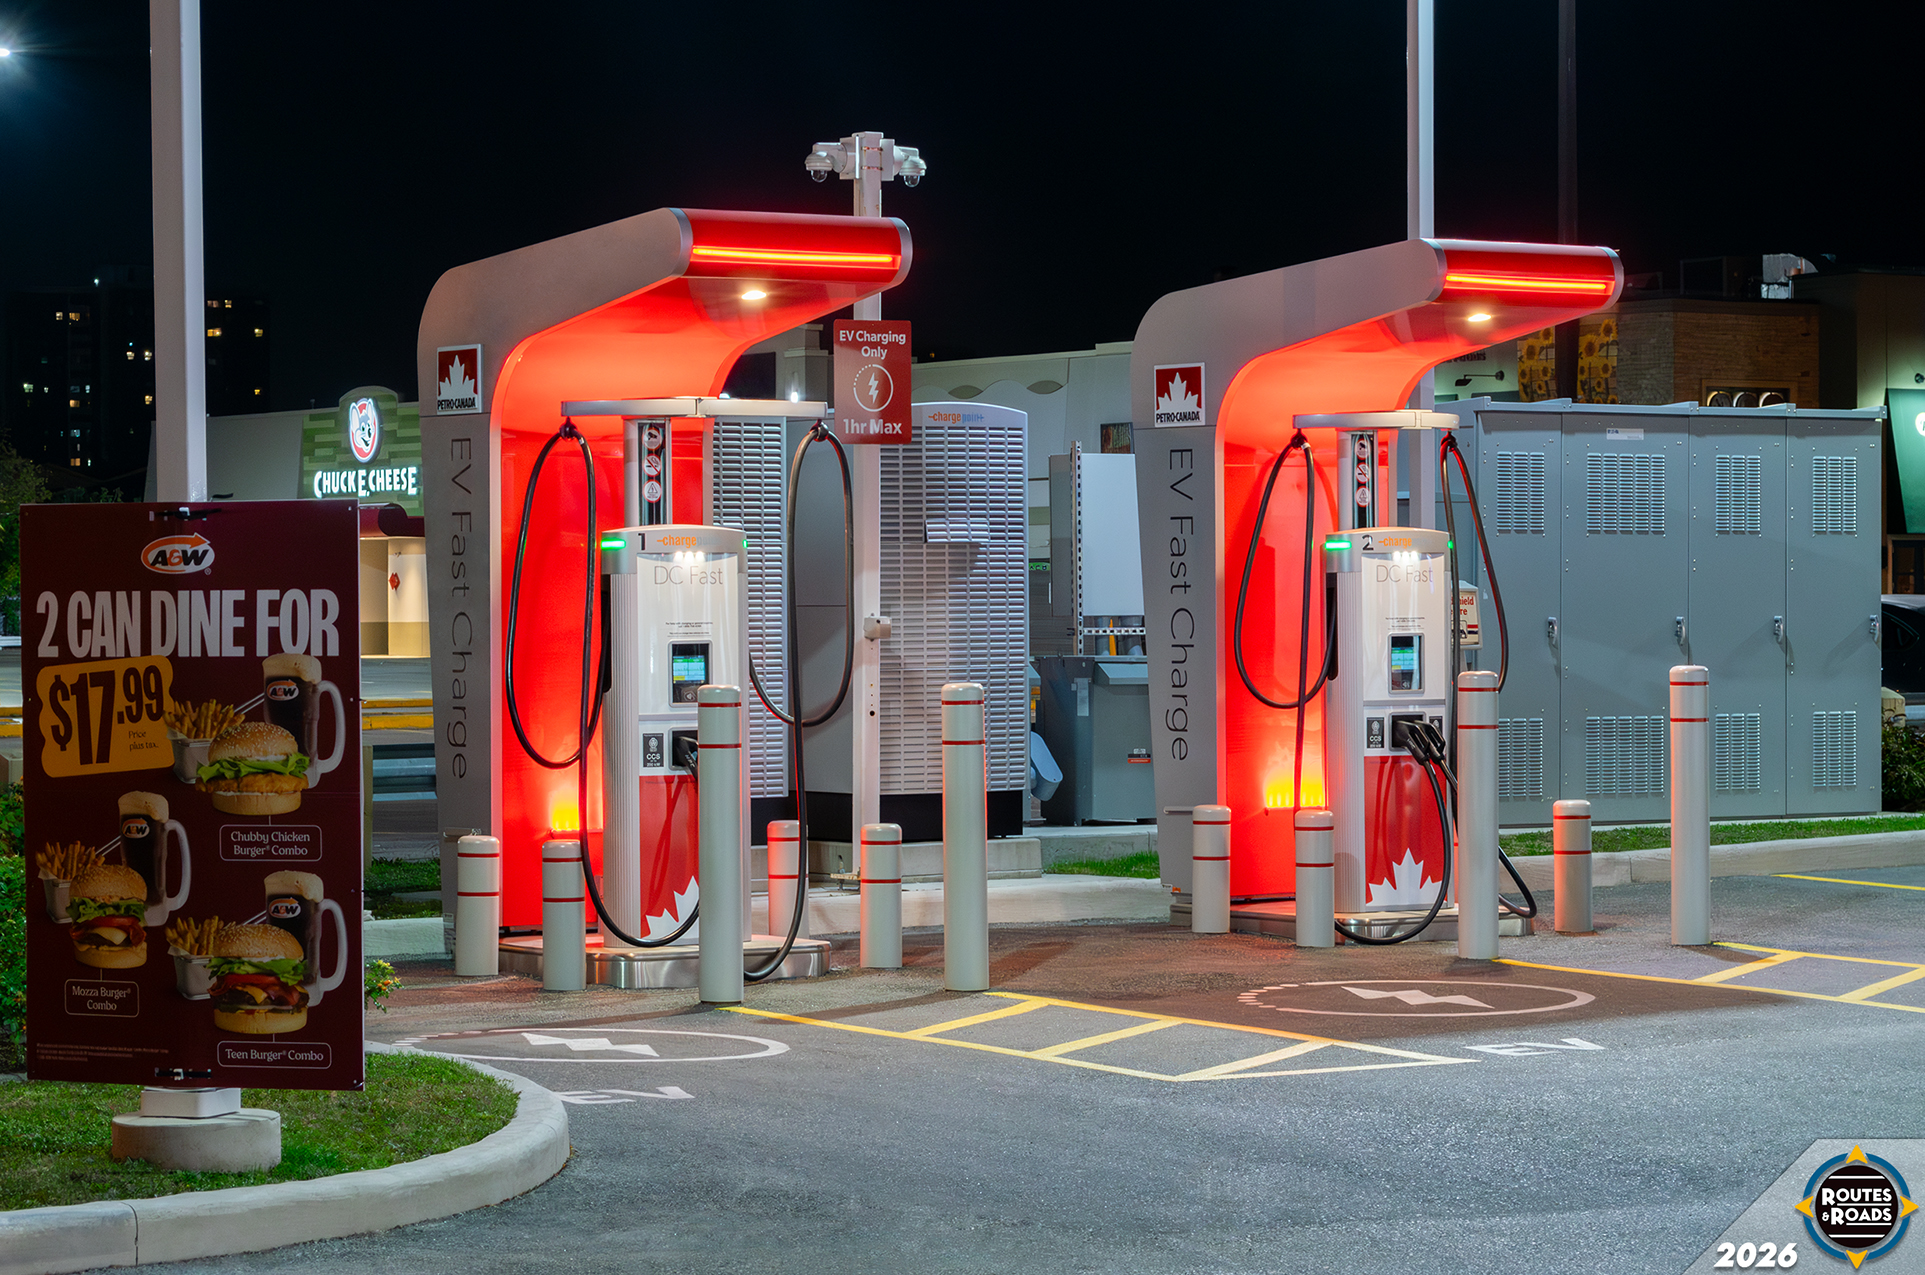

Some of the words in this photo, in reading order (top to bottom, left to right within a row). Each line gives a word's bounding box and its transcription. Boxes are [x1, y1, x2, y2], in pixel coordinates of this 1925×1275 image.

[839, 330, 855, 341] EV
[856, 330, 906, 345] Charging
[861, 346, 887, 360] Only
[843, 418, 867, 434] 1hr
[869, 418, 902, 434] Max
[451, 438, 472, 494] EV
[1169, 448, 1194, 501] EV
[313, 470, 357, 499] CHUCK
[367, 466, 417, 496] CHEESE
[637, 532, 646, 551] 1
[1361, 534, 1375, 551] 2
[150, 549, 210, 567] A&W
[451, 511, 472, 597] Fast
[1169, 516, 1194, 595] Fast
[653, 565, 684, 585] DC
[689, 565, 724, 585] Fast
[1375, 564, 1402, 583] DC
[1405, 564, 1434, 583] Fast
[36, 590, 59, 658] 2
[66, 590, 141, 659] CAN
[150, 589, 246, 658] DINE
[256, 588, 340, 657] FOR
[1165, 607, 1195, 761] Charge
[447, 611, 473, 779] Charge
[48, 664, 164, 766] $17.99
[230, 831, 269, 844] Chubby
[271, 831, 311, 842] Chicken
[271, 845, 309, 856] Combo
[72, 985, 99, 997] Mozza
[86, 999, 118, 1011] Combo
[225, 1049, 249, 1060] Teen
[287, 1050, 324, 1061] Combo
